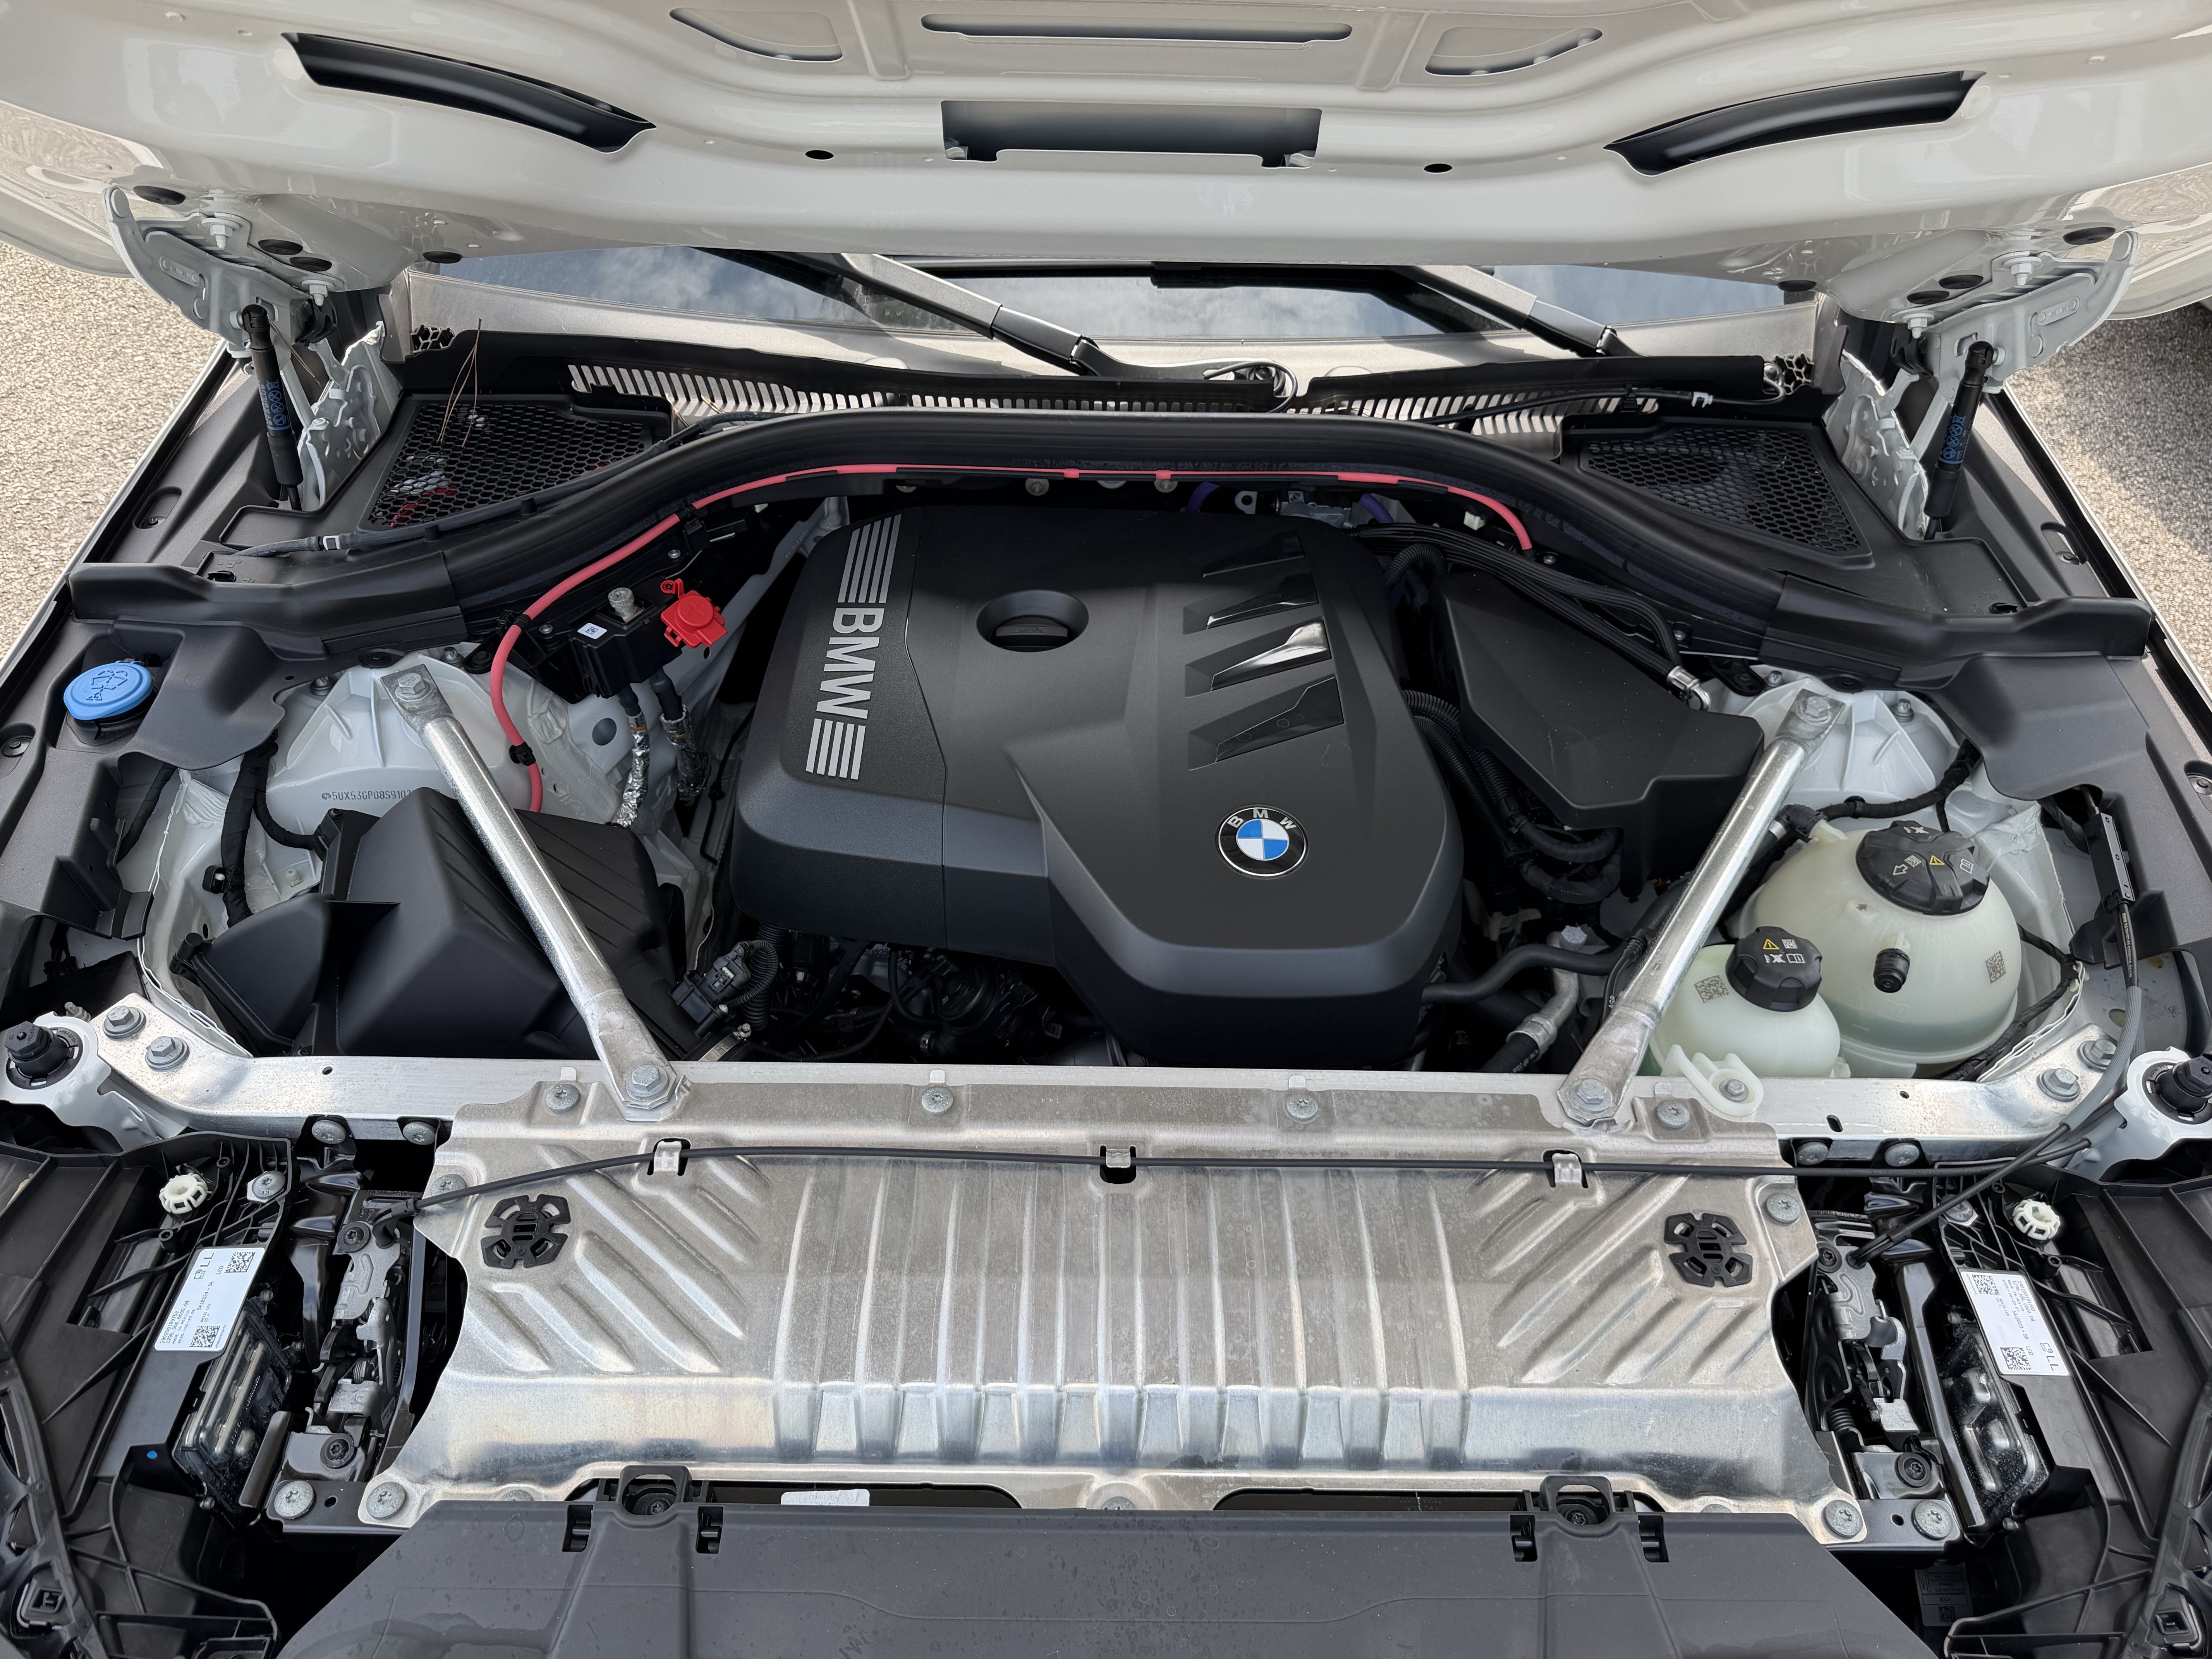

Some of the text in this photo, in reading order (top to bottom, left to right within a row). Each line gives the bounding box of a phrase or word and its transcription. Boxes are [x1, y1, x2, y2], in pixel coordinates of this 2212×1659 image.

[816, 608, 884, 719] BMW
[1227, 809, 1297, 829] BMW
[199, 1252, 215, 1267] LL
[215, 1266, 224, 1274] LED
[171, 1333, 179, 1343] MADE
[180, 1309, 191, 1324] MEXICO
[2025, 1346, 2034, 1355] LED
[2045, 1355, 2061, 1371] LL
